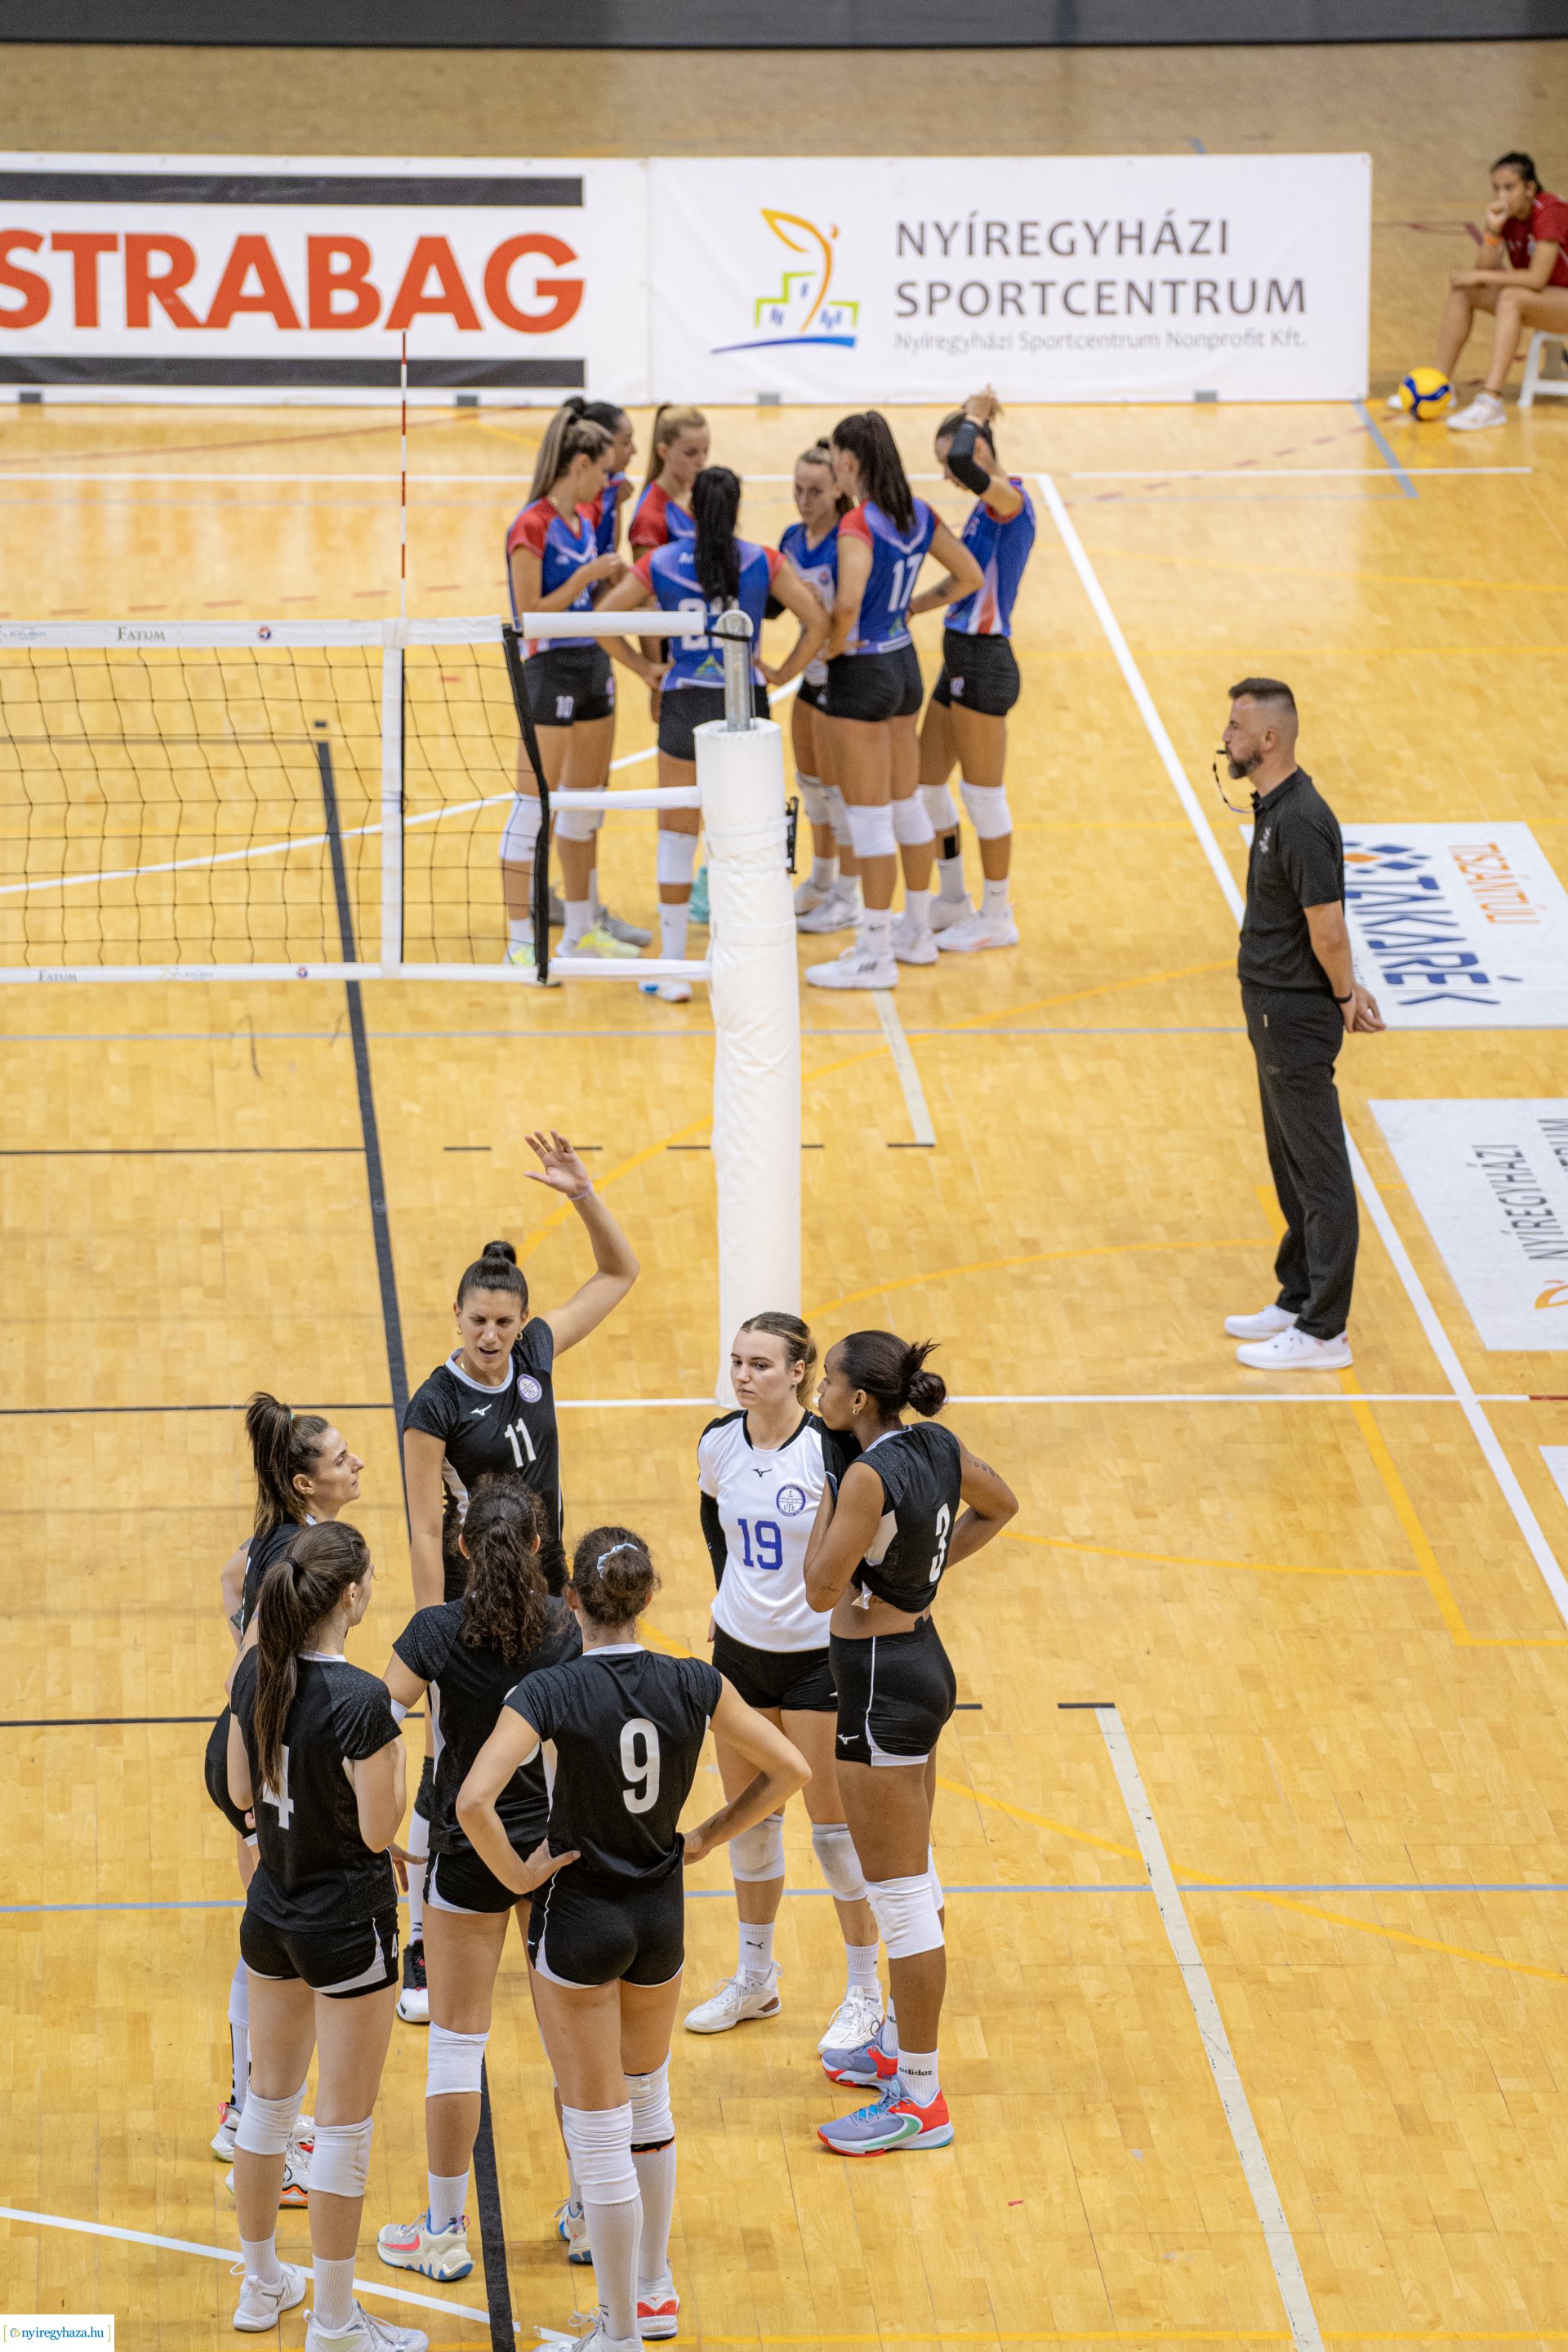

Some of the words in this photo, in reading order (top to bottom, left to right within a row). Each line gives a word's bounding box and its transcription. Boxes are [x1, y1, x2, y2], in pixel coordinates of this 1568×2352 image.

[896, 210, 1230, 257] NYÍREGYHÁZI
[0, 229, 586, 334] STRABAG
[895, 278, 1307, 318] SPORTCENTRUM
[1018, 331, 1161, 353] Sportcentrum
[888, 553, 924, 612] 17
[118, 626, 165, 641] FATUM
[1343, 875, 1523, 1005] TAKARÉK
[504, 1418, 537, 1468] 11
[737, 1518, 783, 1570] 19
[929, 1503, 951, 1583] 3
[261, 1744, 294, 1830] 4
[620, 1718, 661, 1814] 9
[899, 2067, 933, 2076] adidas
